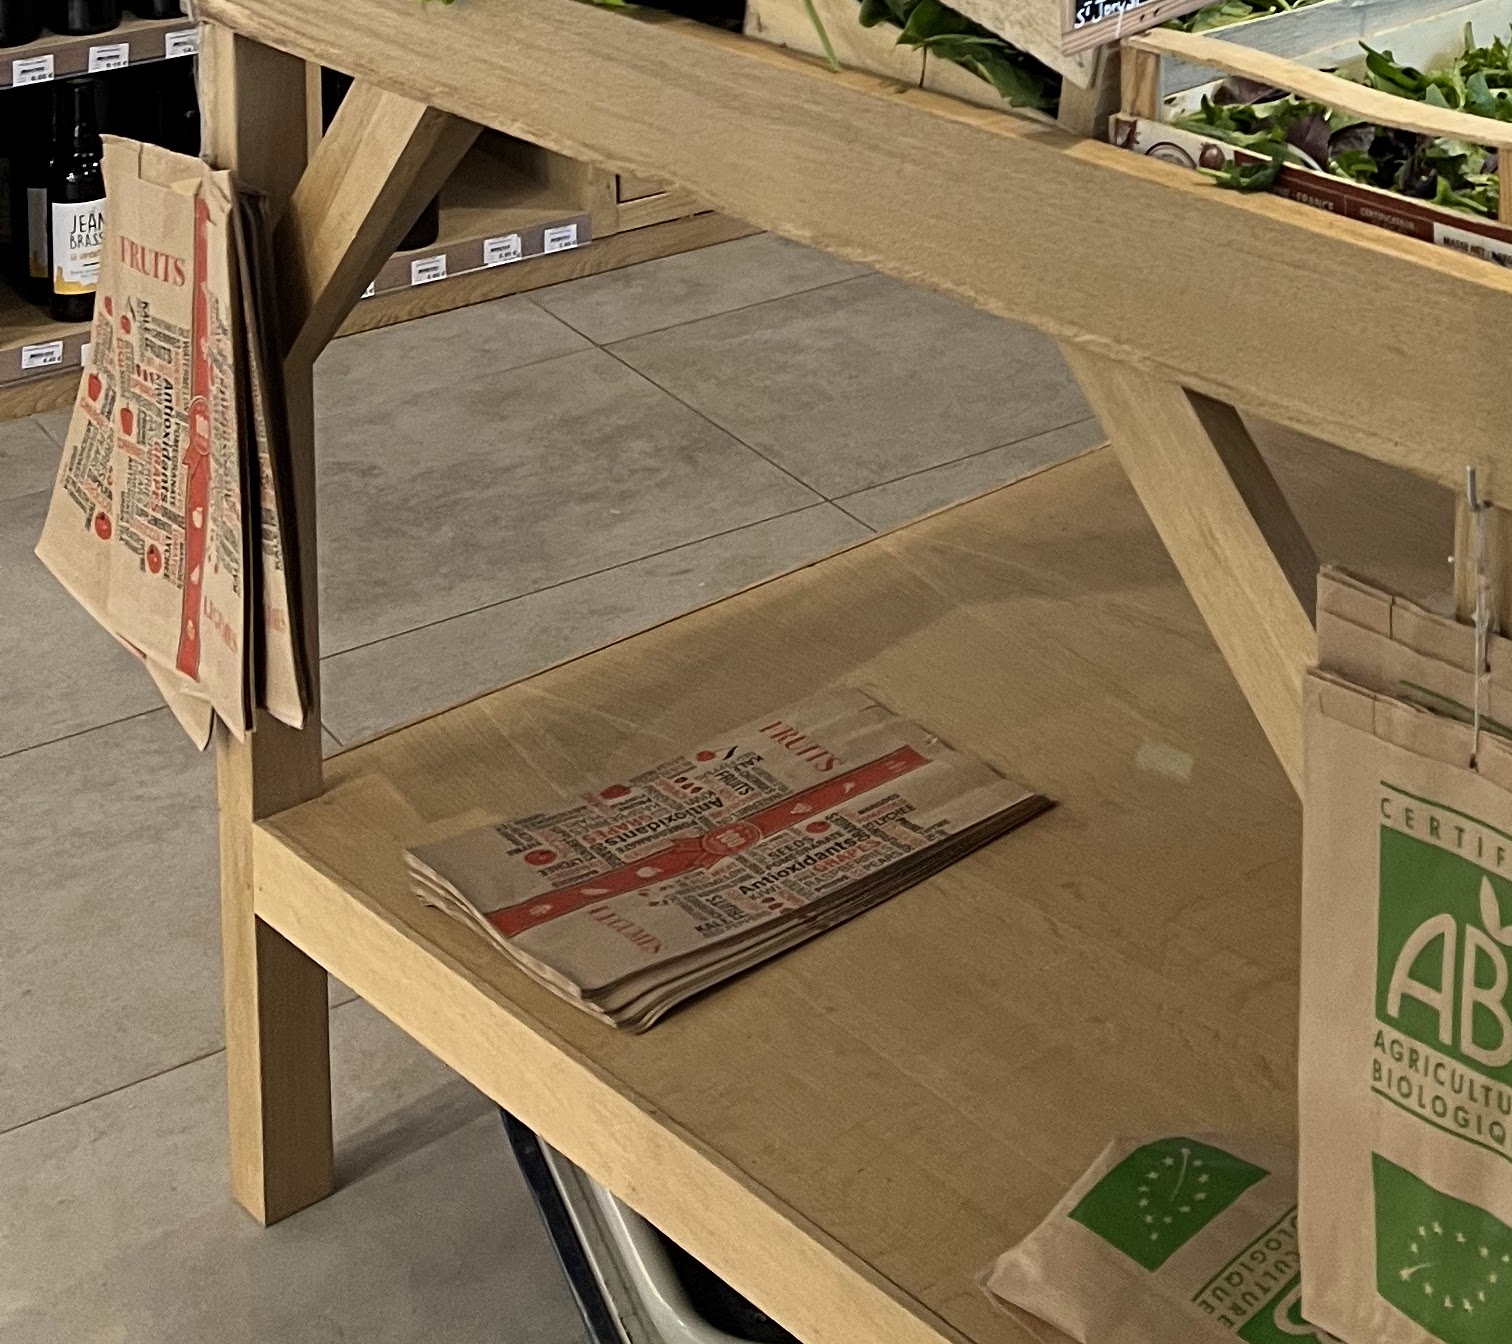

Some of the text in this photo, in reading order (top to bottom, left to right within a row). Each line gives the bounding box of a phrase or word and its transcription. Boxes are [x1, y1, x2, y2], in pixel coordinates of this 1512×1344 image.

[70, 232, 106, 251] BRASS
[71, 212, 107, 235] JEAN
[119, 235, 187, 289] FRUITS
[159, 378, 175, 505] Antioxidants
[759, 720, 843, 773] FRUITS
[738, 830, 872, 897] Antioxidants
[1197, 1215, 1299, 1316] OLOGIQUE
[1215, 1248, 1301, 1332] CULTURE
